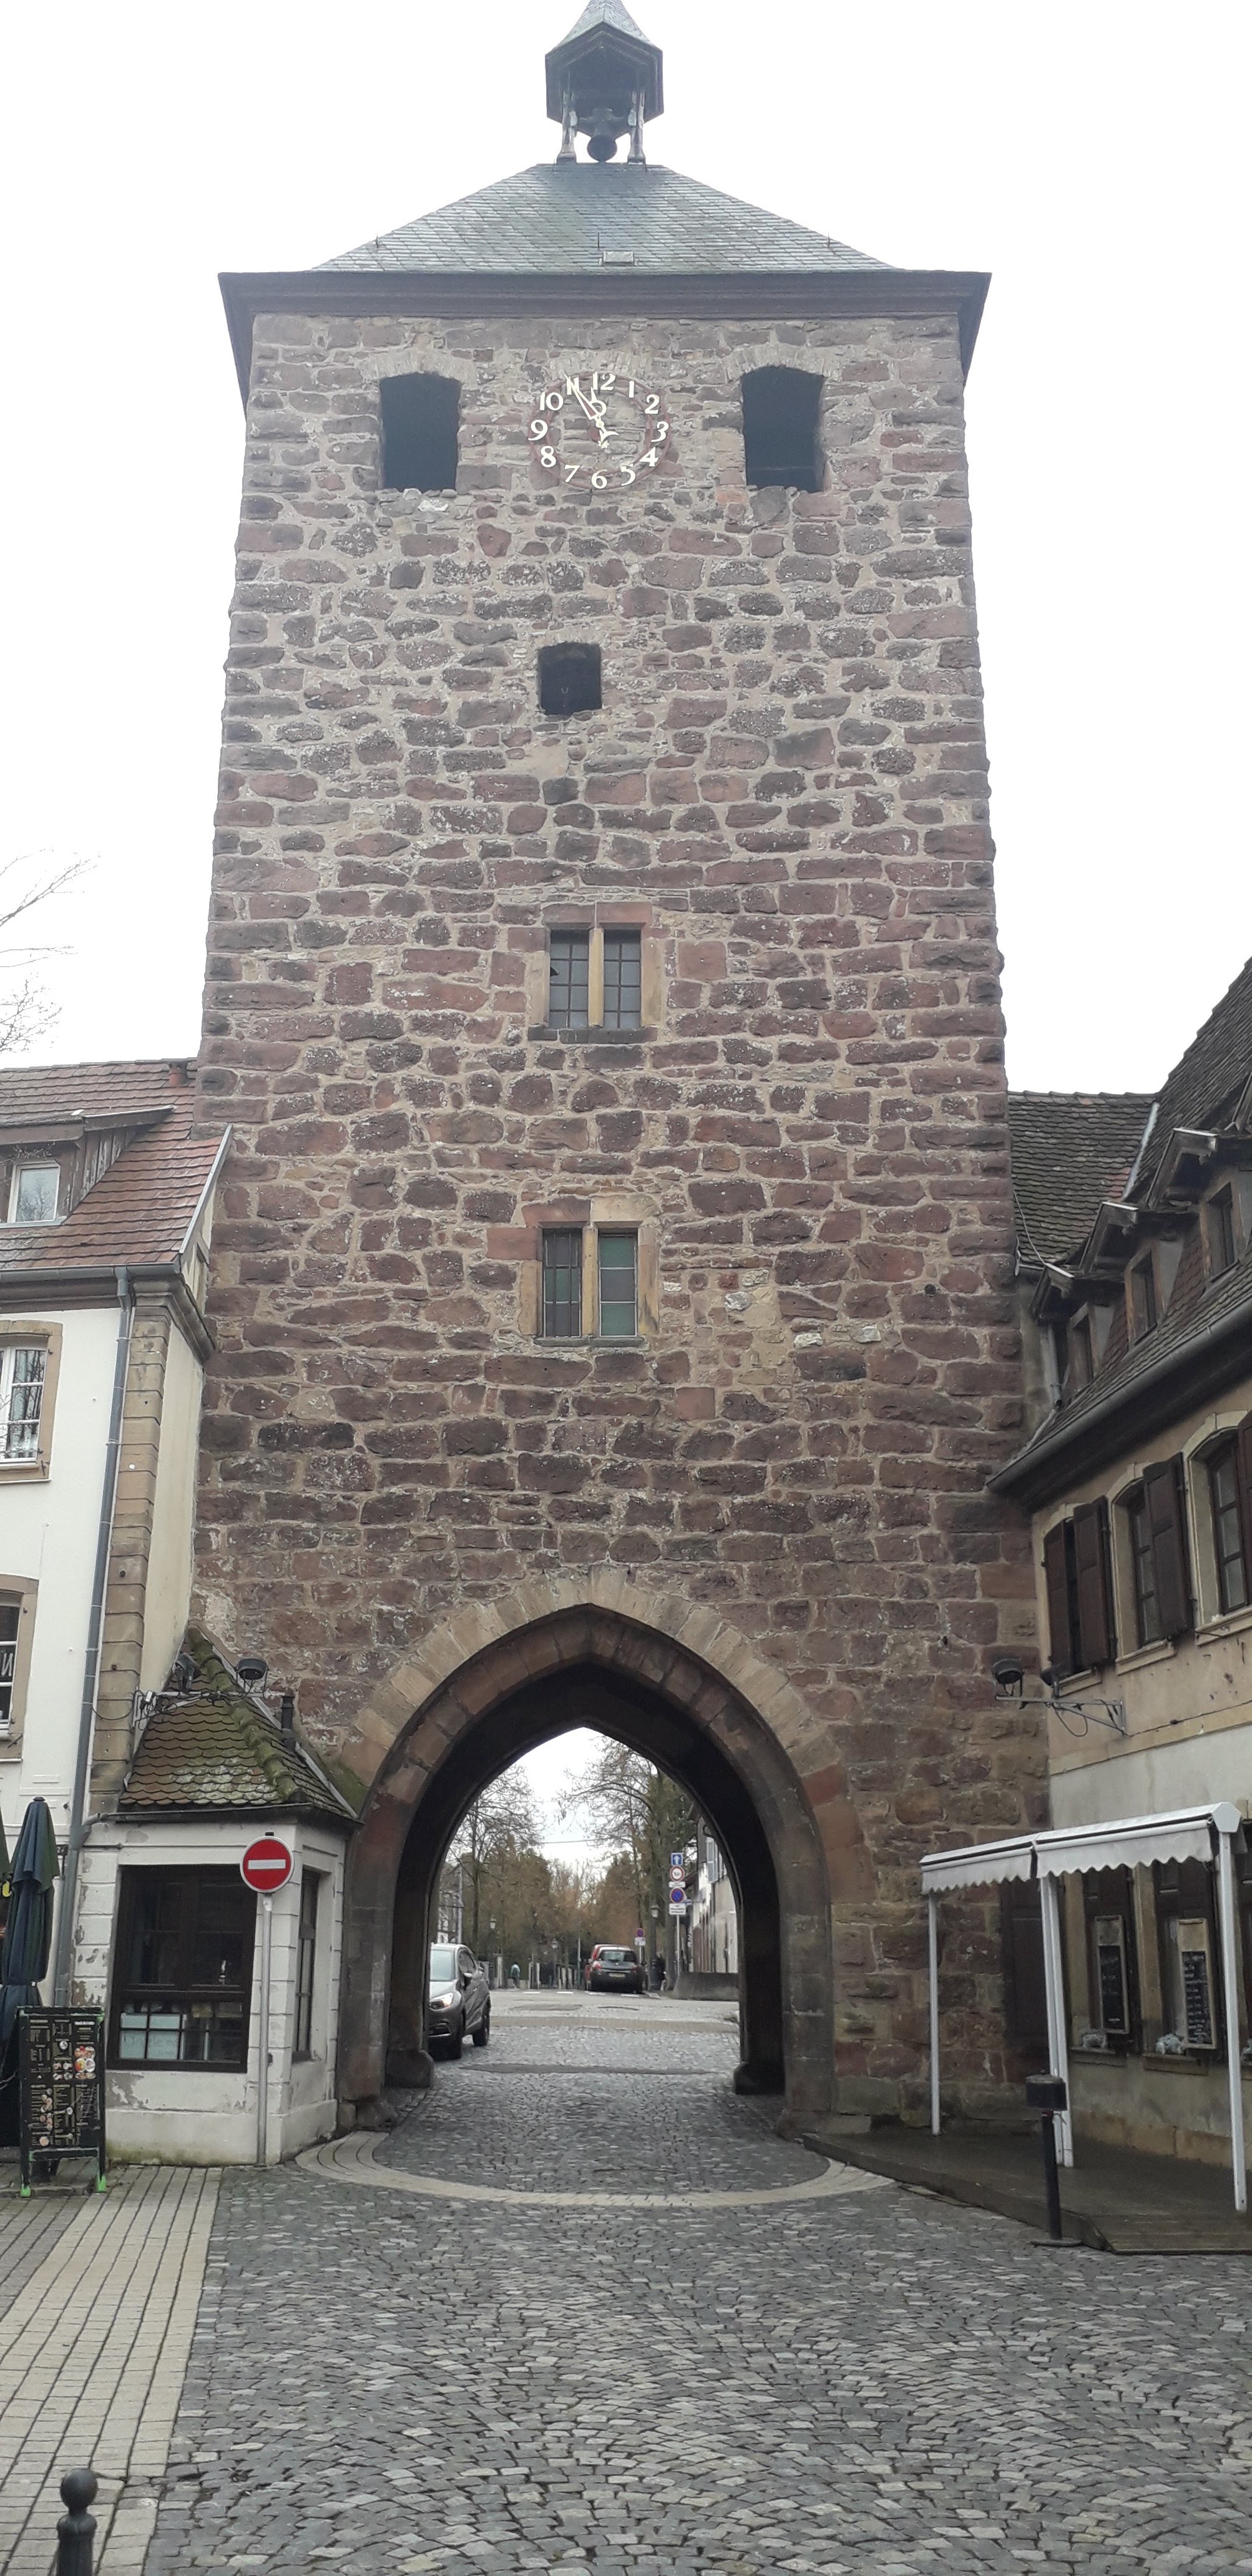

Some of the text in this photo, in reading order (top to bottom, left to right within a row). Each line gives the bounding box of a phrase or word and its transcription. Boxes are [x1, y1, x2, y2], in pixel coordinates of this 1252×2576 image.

[592, 371, 616, 391] 12
[628, 381, 635, 398] 1
[539, 391, 564, 411] 10
[644, 394, 660, 414] 2
[527, 419, 548, 441] 9
[650, 421, 669, 442] 3
[540, 446, 557, 468] 8
[638, 446, 659, 467] 4
[564, 464, 580, 482] 7
[591, 469, 607, 489] 6
[620, 463, 636, 486] 5
